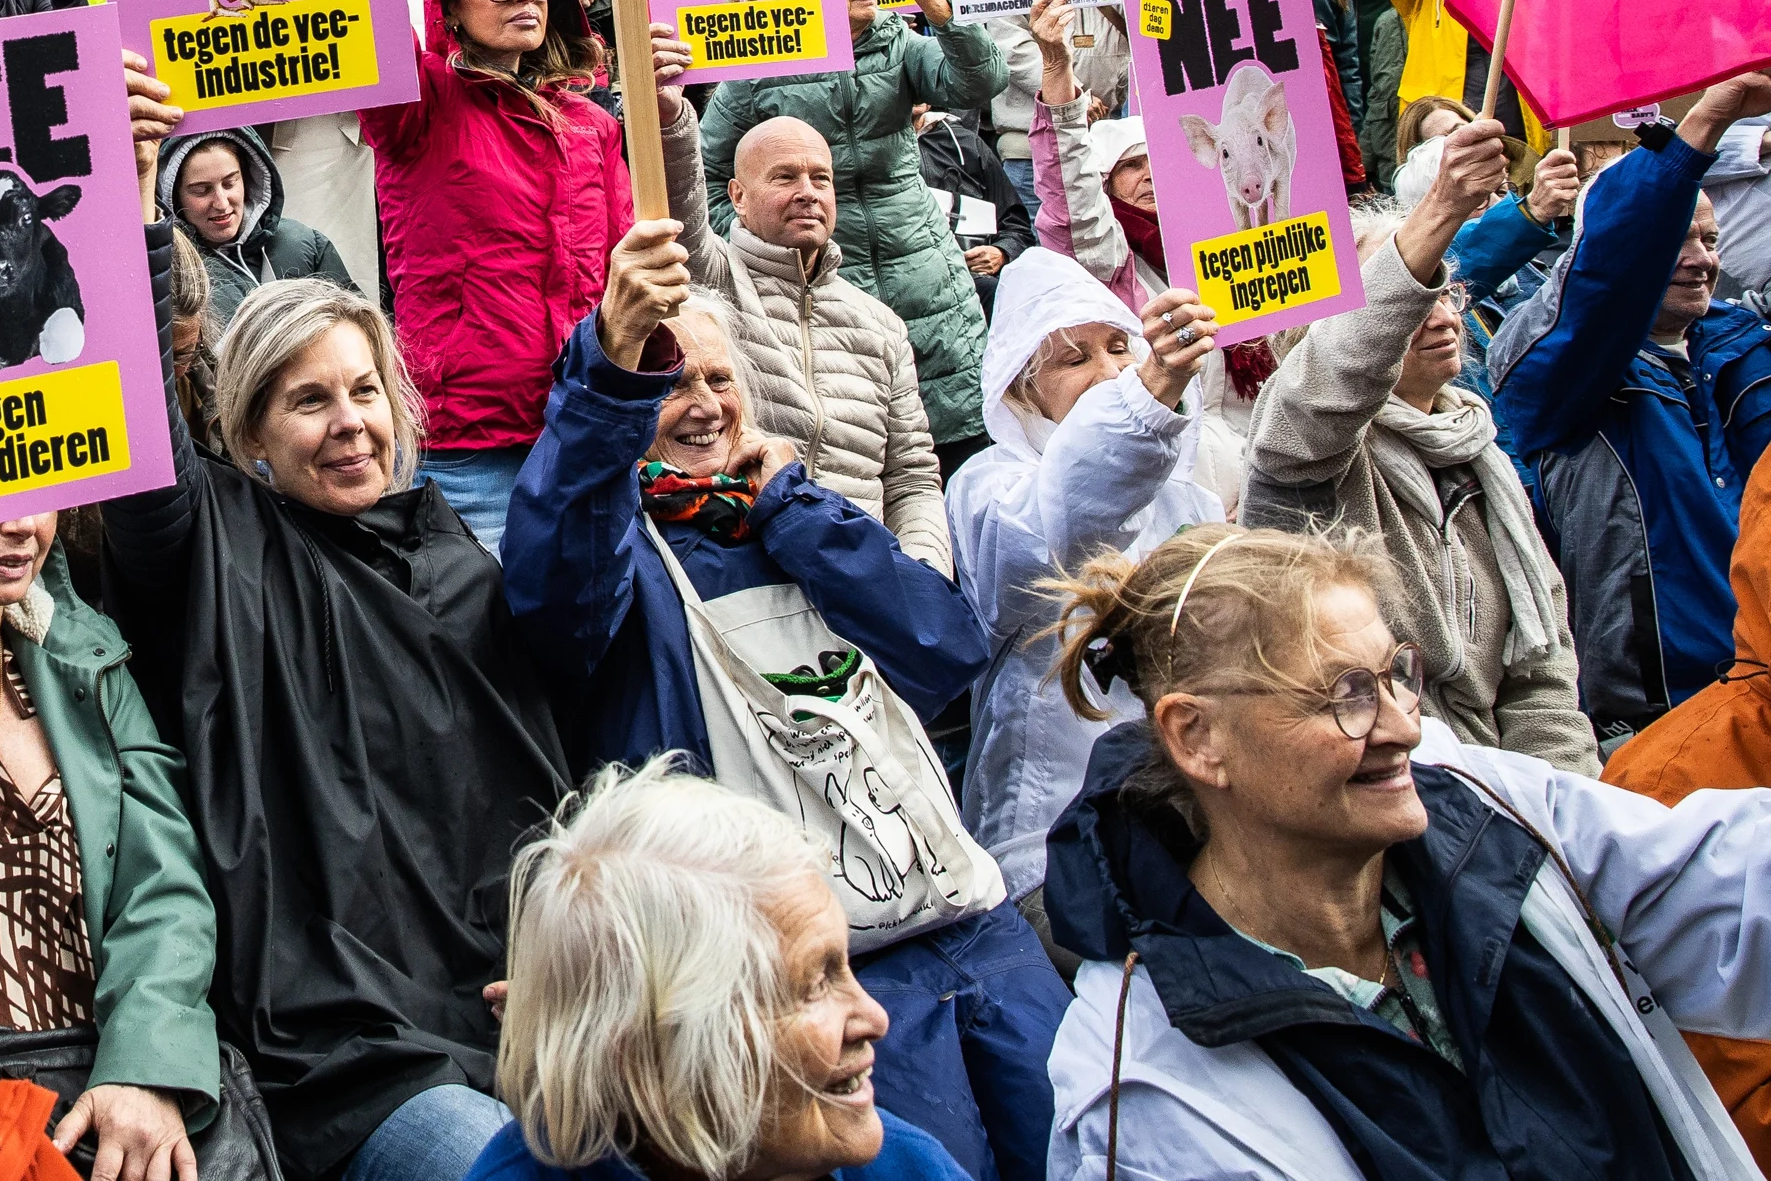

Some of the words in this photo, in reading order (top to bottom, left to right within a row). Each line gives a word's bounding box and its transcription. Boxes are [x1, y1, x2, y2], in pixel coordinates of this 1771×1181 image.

[684, 7, 742, 37] tegen
[744, 9, 771, 33] de
[772, 6, 816, 27] vee-
[1142, 1, 1170, 18] dieren
[1145, 23, 1165, 36] demo
[162, 16, 250, 67] tegen
[253, 10, 288, 49] de
[292, 6, 361, 41] vee-
[704, 29, 803, 63] industrie!
[193, 43, 342, 100] industrie!
[1198, 242, 1255, 285] tegen
[1252, 222, 1328, 272] pijnlijke
[1229, 264, 1312, 312] ingrepen
